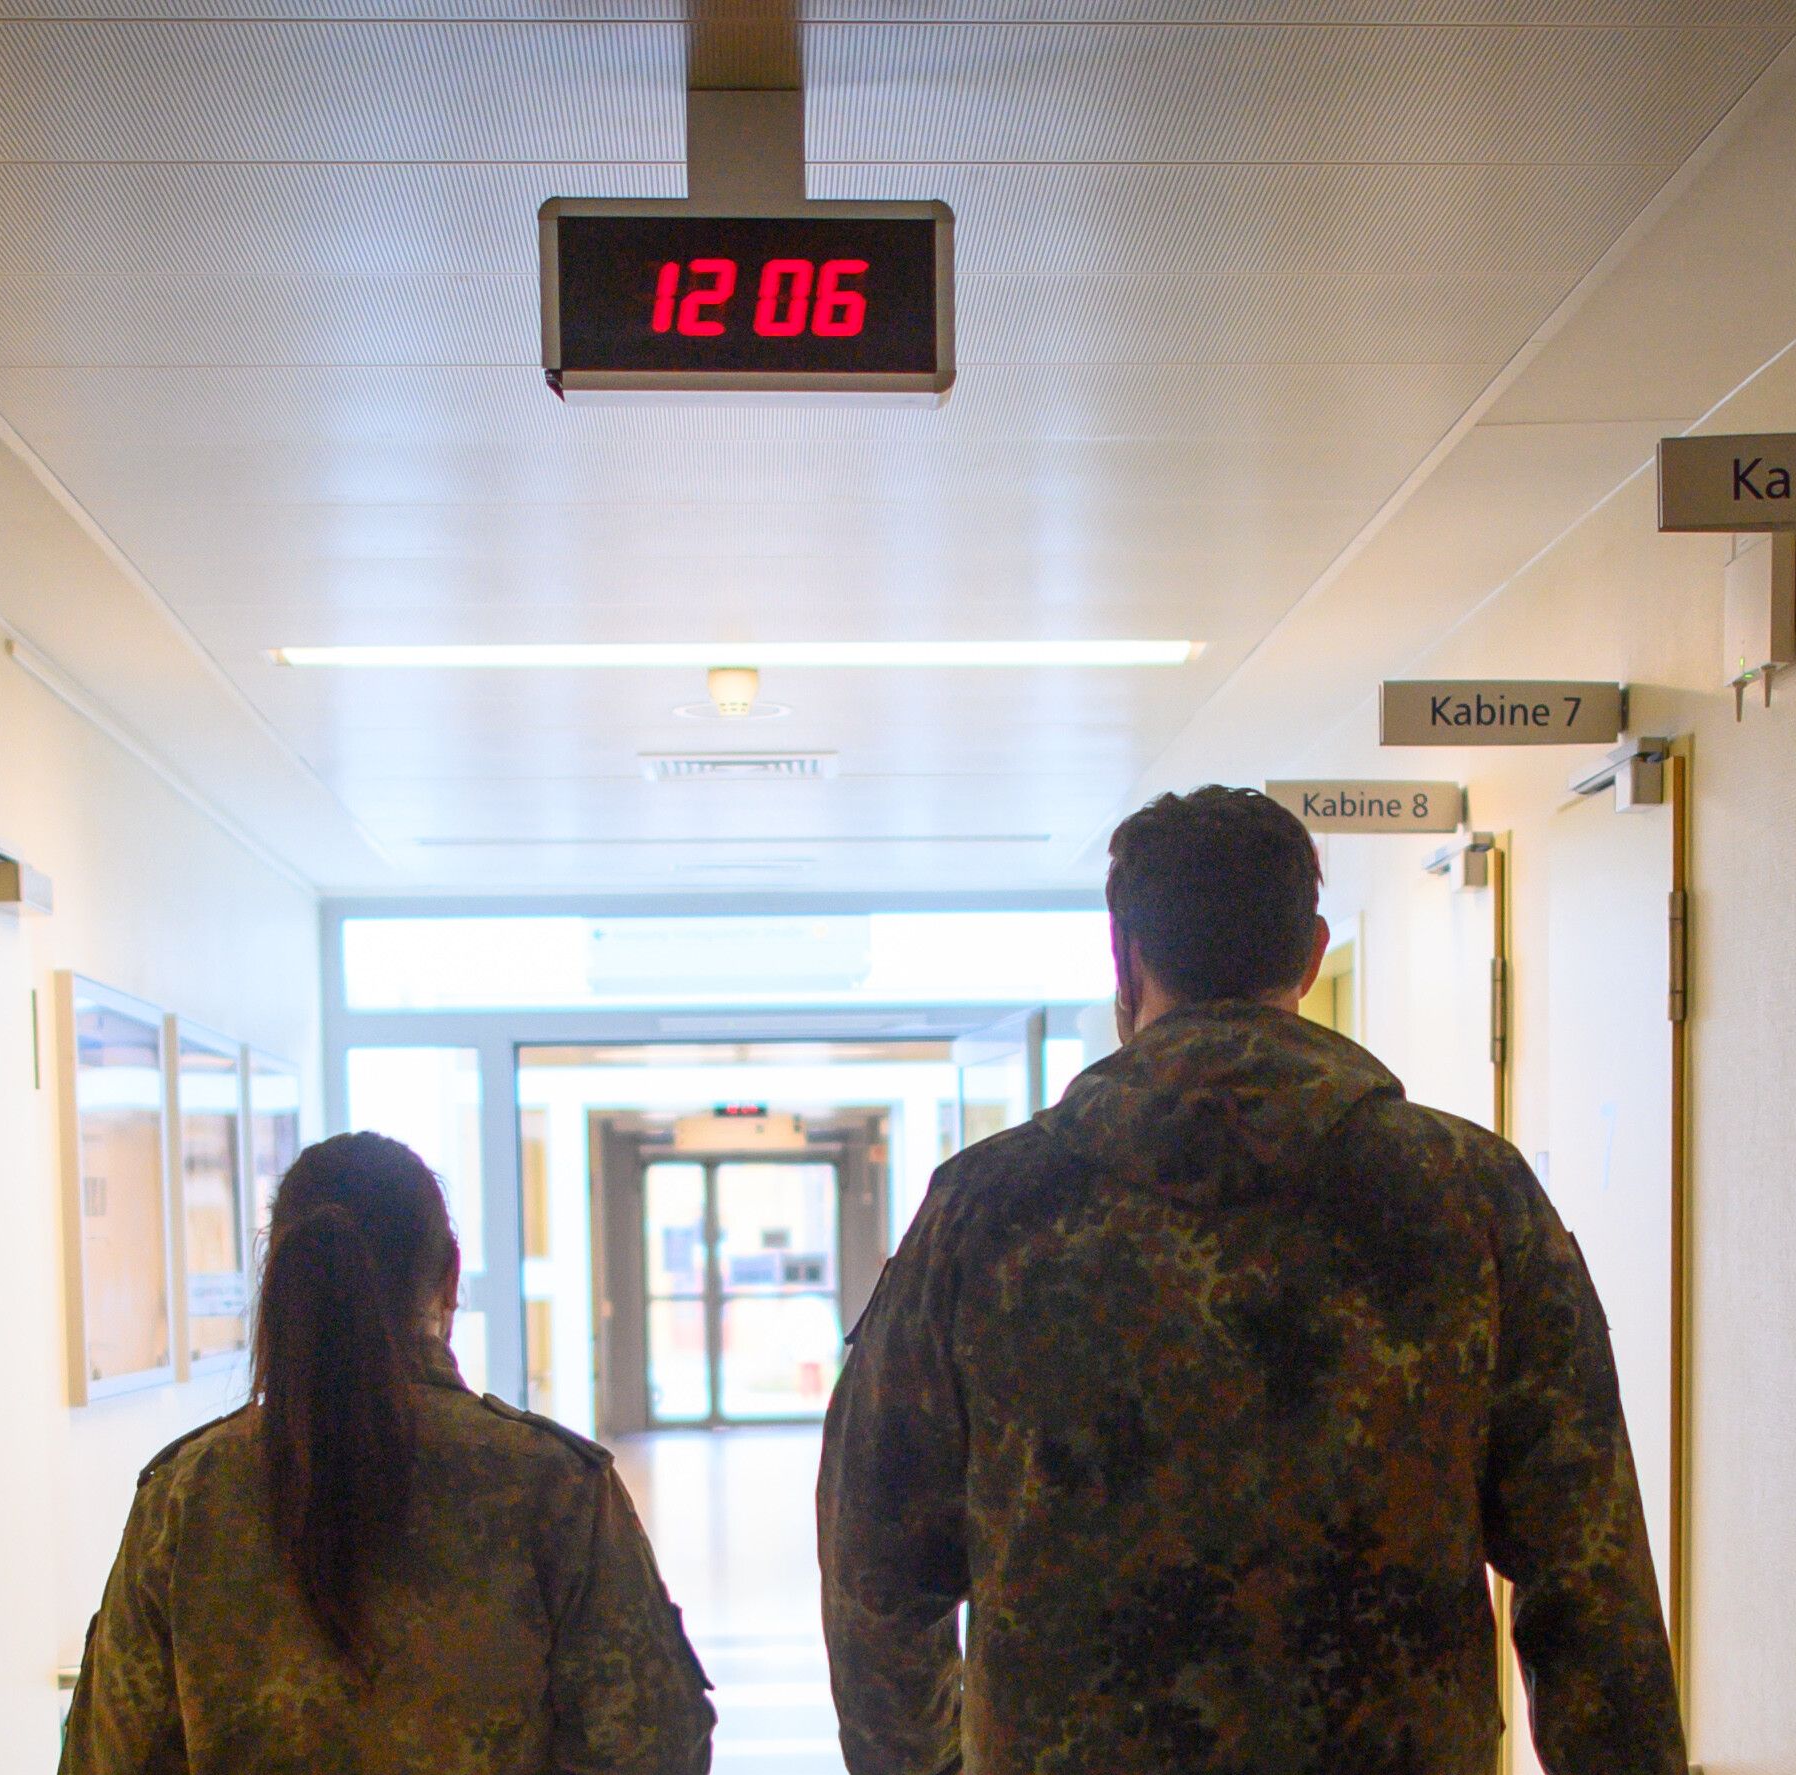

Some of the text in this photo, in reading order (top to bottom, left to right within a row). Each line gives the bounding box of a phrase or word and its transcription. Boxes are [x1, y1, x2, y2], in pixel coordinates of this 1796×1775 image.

[1430, 692, 1583, 728] Kabine 7
[1303, 791, 1429, 819] Kabine 8
